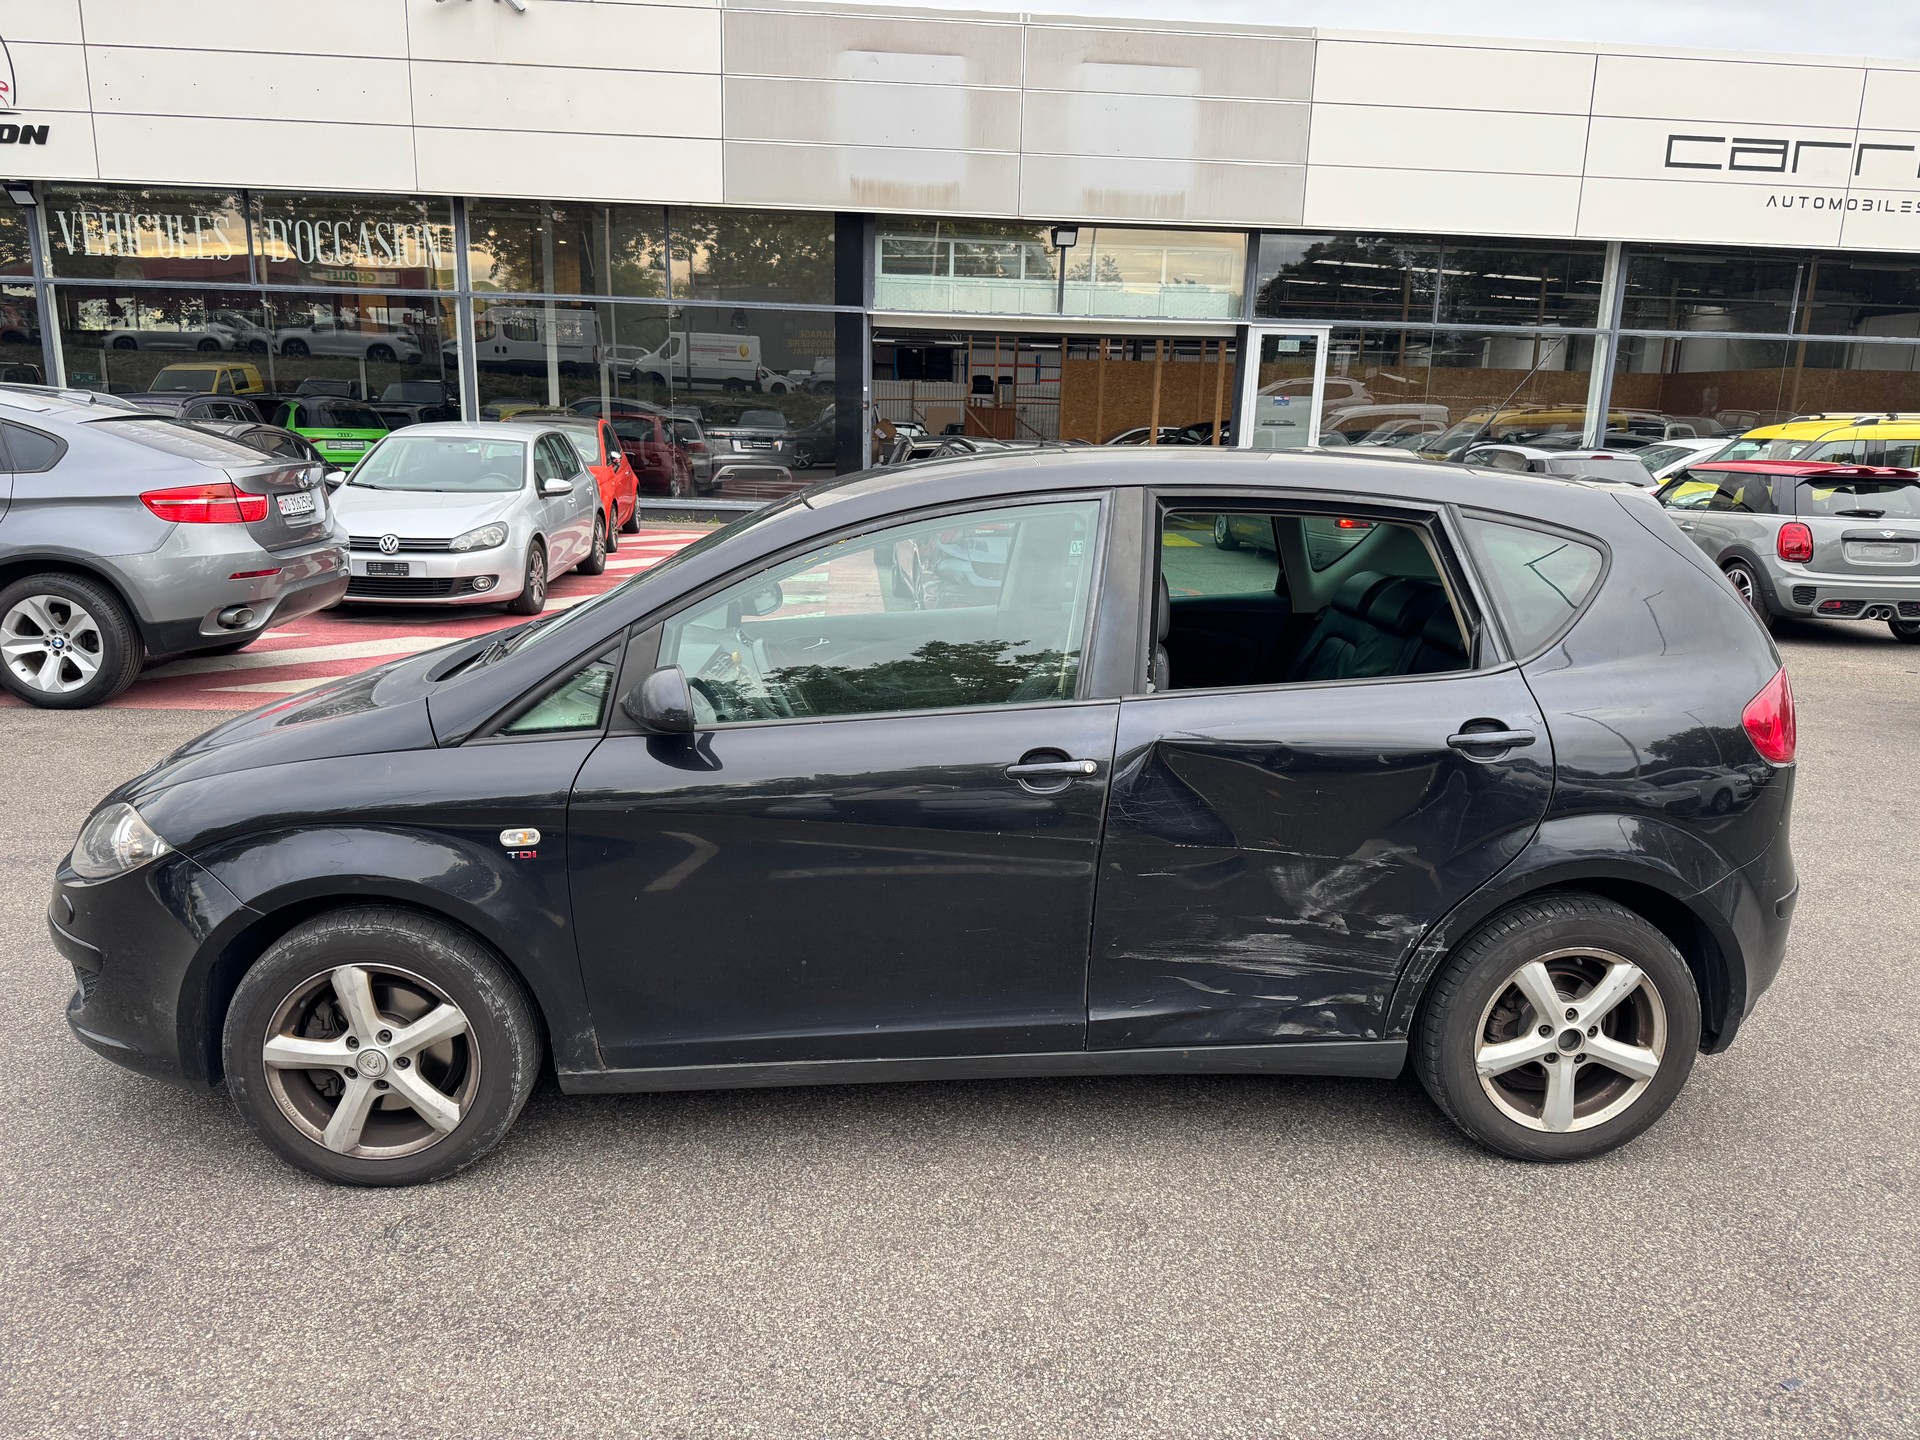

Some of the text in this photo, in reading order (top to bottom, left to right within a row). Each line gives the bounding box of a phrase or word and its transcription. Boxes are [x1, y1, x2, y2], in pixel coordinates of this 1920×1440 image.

[1665, 135, 1920, 178] carr
[55, 211, 443, 268] VEHICULES D'OCCASION
[506, 850, 537, 859] TDI
